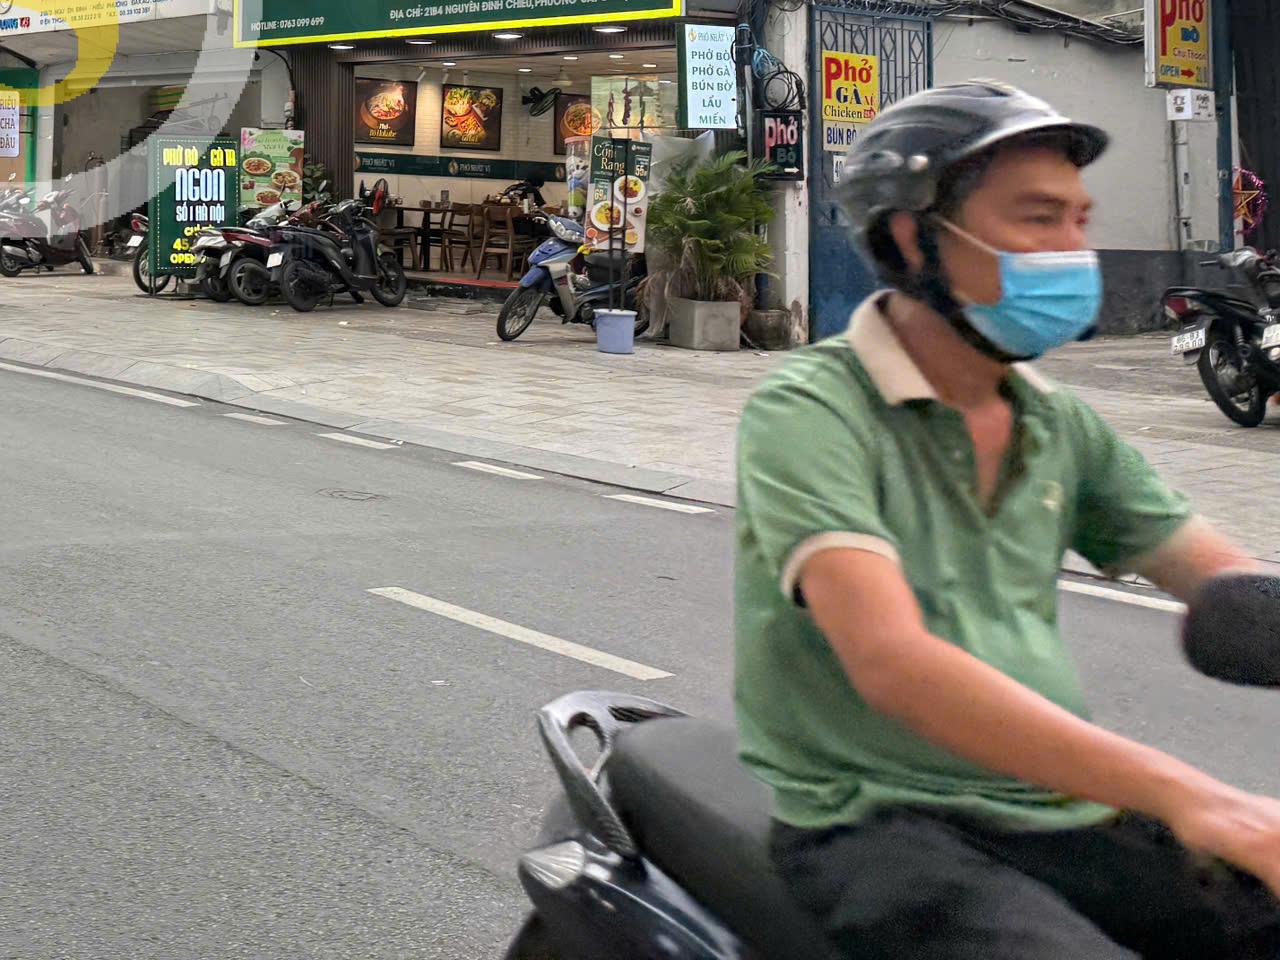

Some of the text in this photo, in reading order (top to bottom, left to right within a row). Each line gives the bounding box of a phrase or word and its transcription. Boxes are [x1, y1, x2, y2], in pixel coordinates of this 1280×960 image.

[390, 9, 404, 21] ĐỊA
[691, 49, 731, 61] PHỞ BÒ
[692, 64, 731, 77] PHỞ GÀ
[692, 79, 714, 91] BÚN
[824, 57, 873, 100] Phở
[835, 84, 862, 105] GÀ
[824, 105, 862, 119] Chicken
[827, 124, 844, 145] BÚN
[162, 145, 183, 166] PHỞ
